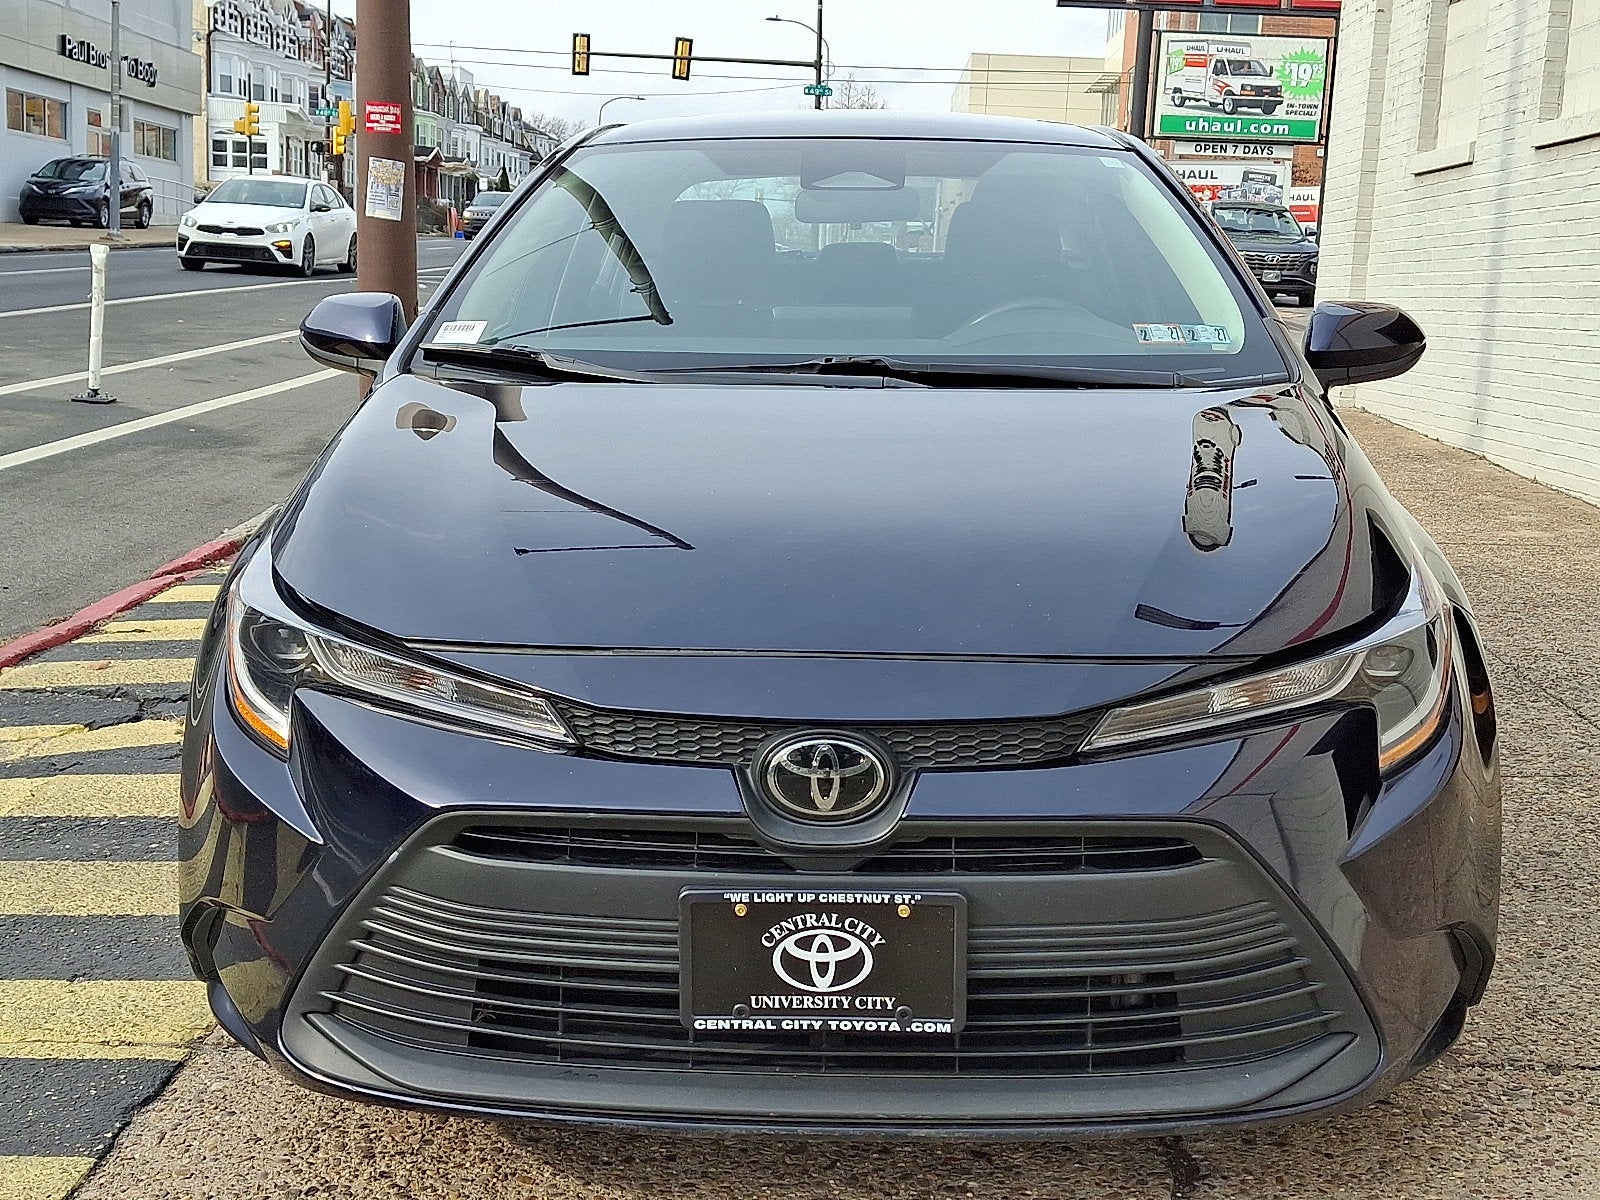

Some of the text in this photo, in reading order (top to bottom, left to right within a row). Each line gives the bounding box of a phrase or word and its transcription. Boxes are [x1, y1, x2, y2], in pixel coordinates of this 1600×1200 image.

[65, 35, 88, 62] Paul
[1286, 102, 1319, 110] IN-TOWN
[1185, 118, 1290, 135] uhaul.com
[1194, 143, 1275, 156] OPEN 7 DAYS
[753, 892, 794, 903] LIGHT
[797, 893, 816, 903] UP
[818, 893, 890, 904] CHESTNUT
[761, 913, 887, 949] CENTRAL CITY
[750, 995, 896, 1010] UNIVERSITY CITY
[694, 1019, 951, 1033] CENTRAL CITY TOYOTA .COM
